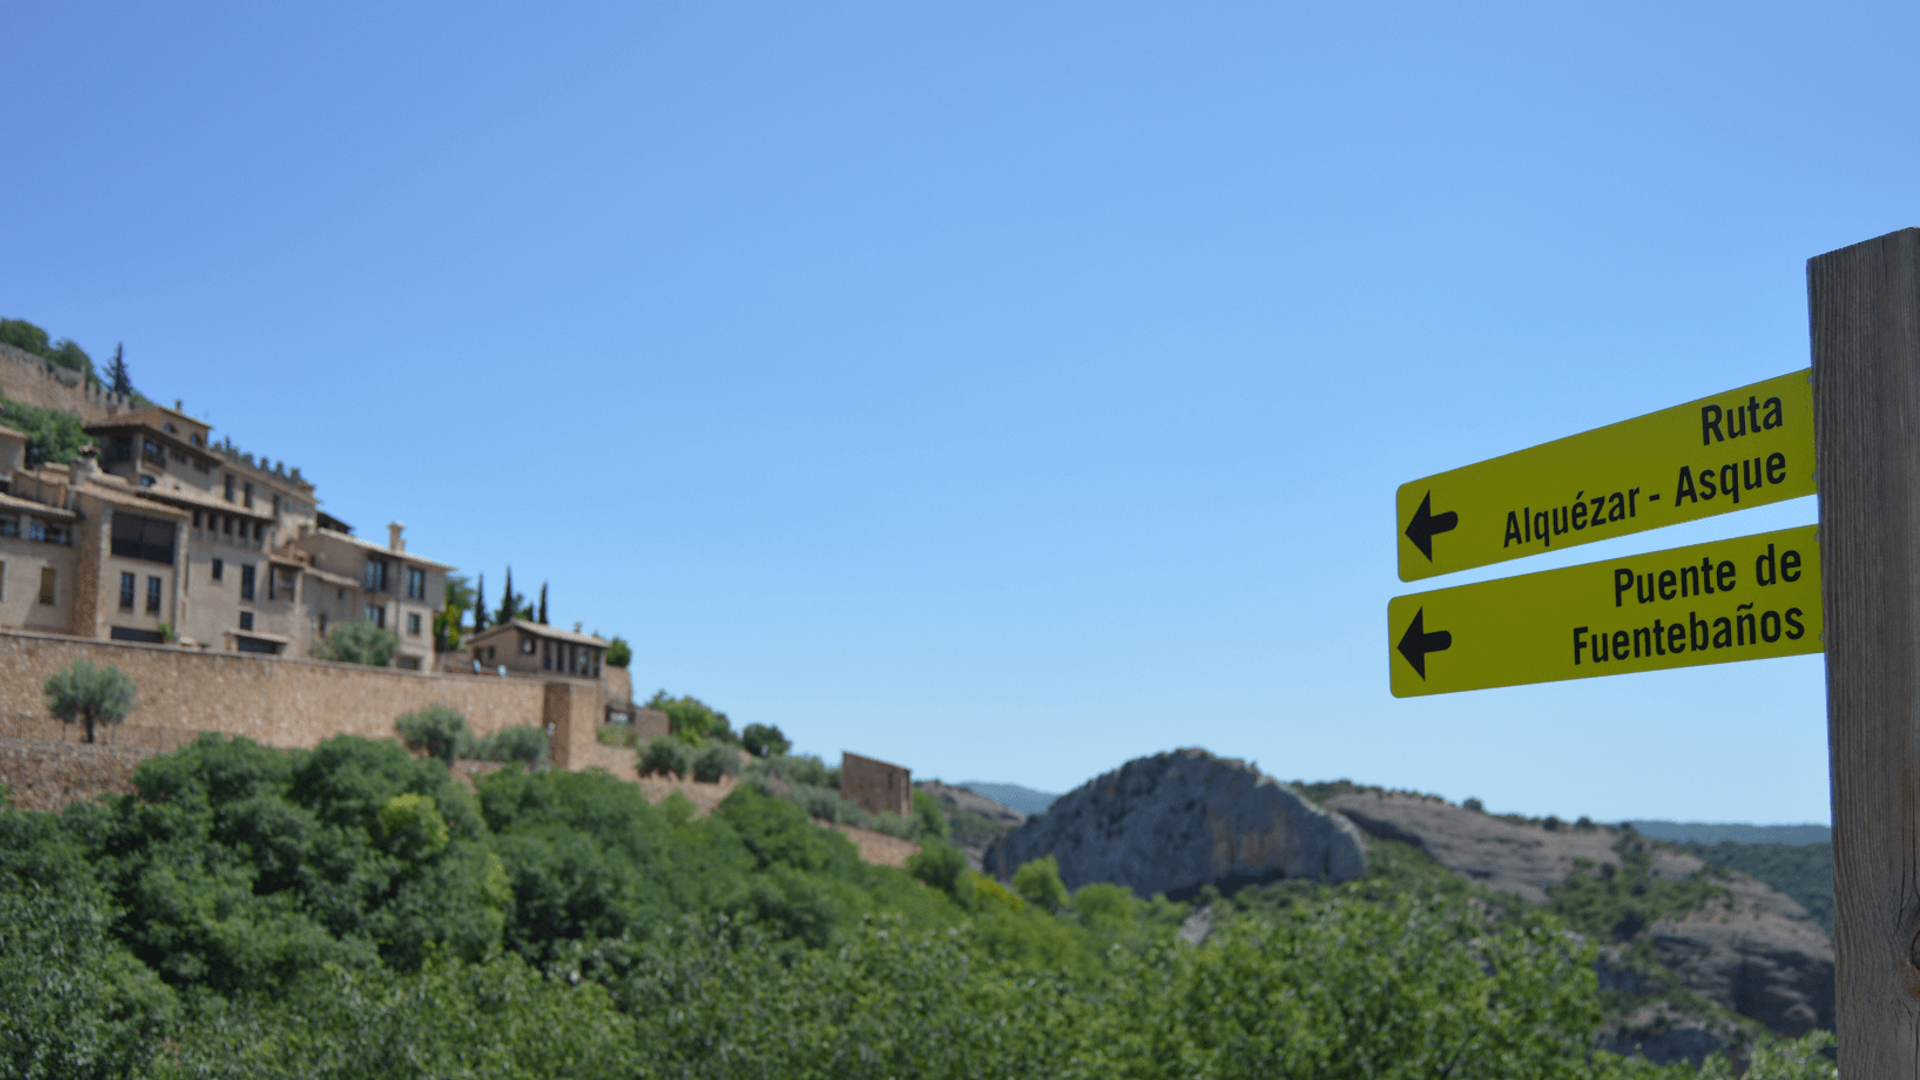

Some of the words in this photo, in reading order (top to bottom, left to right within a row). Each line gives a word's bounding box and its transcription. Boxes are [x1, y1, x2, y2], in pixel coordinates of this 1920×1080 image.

[1701, 395, 1783, 446] Ruta
[1503, 487, 1640, 549] Alquézar
[1648, 493, 1661, 502] -
[1674, 452, 1787, 507] Asque
[1614, 557, 1737, 608] Puente
[1755, 543, 1802, 587] de
[1573, 602, 1805, 665] Fuentebaños
